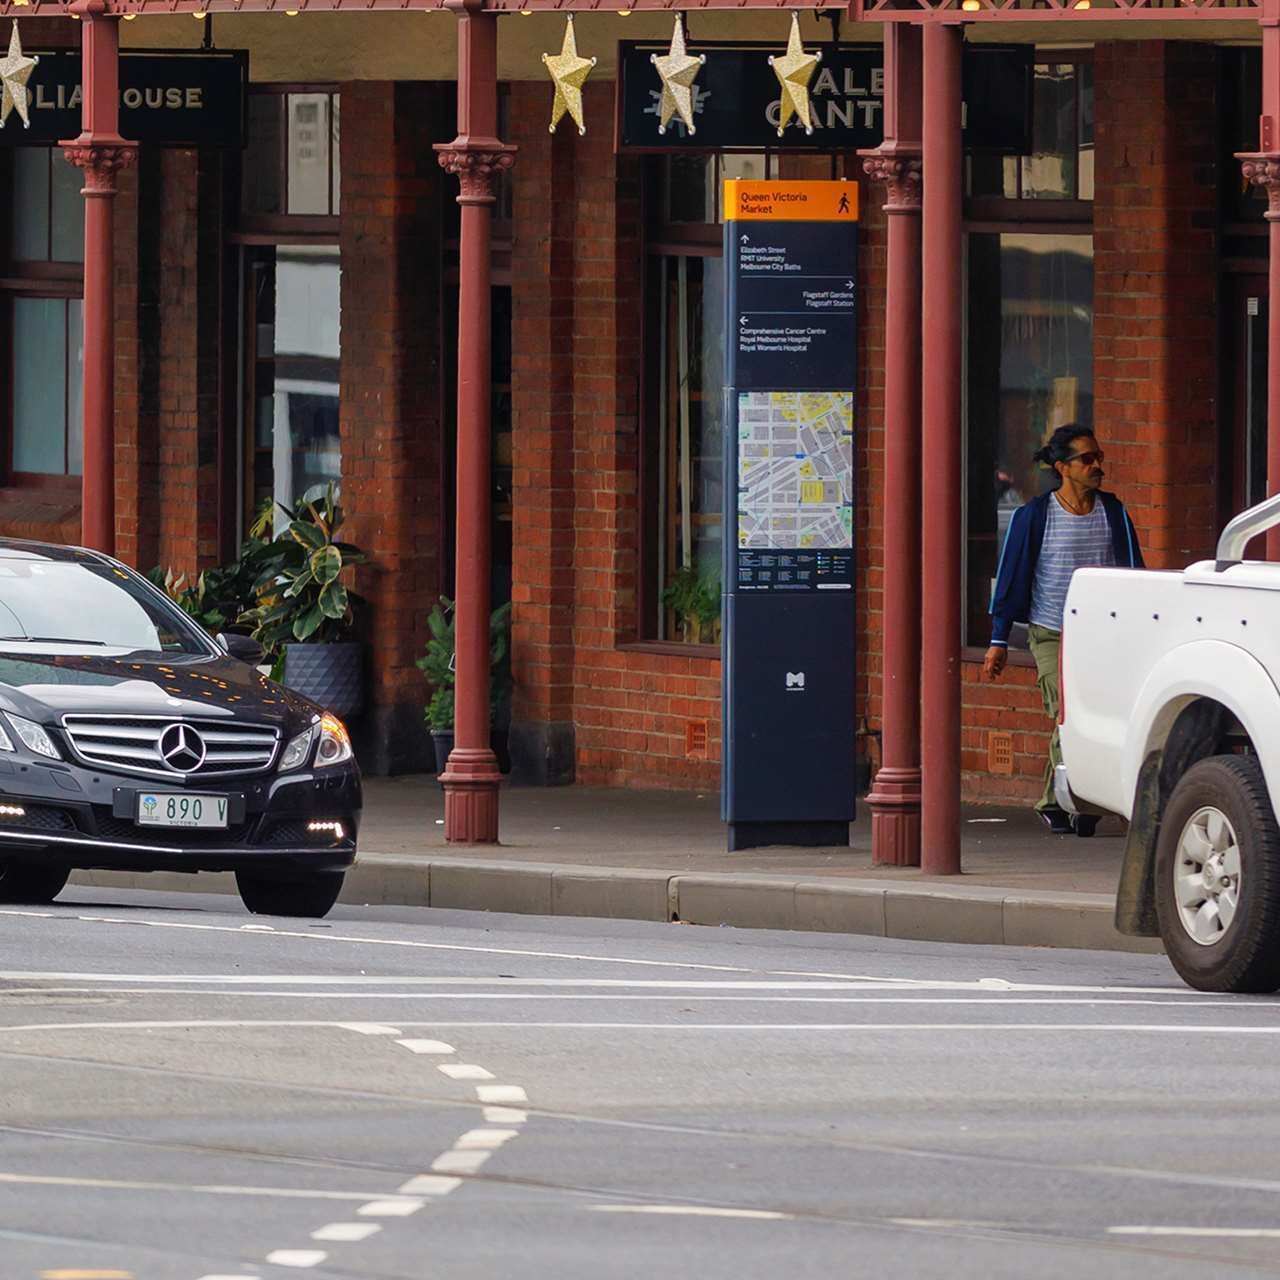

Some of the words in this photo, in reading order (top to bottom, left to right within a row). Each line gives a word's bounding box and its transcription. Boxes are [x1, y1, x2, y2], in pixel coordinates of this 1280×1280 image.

[118, 87, 203, 110] OUSE
[741, 192, 770, 202] Queen
[772, 192, 807, 202] Victoria
[741, 205, 772, 214] Market
[167, 797, 202, 820] 890
[217, 799, 227, 821] V
